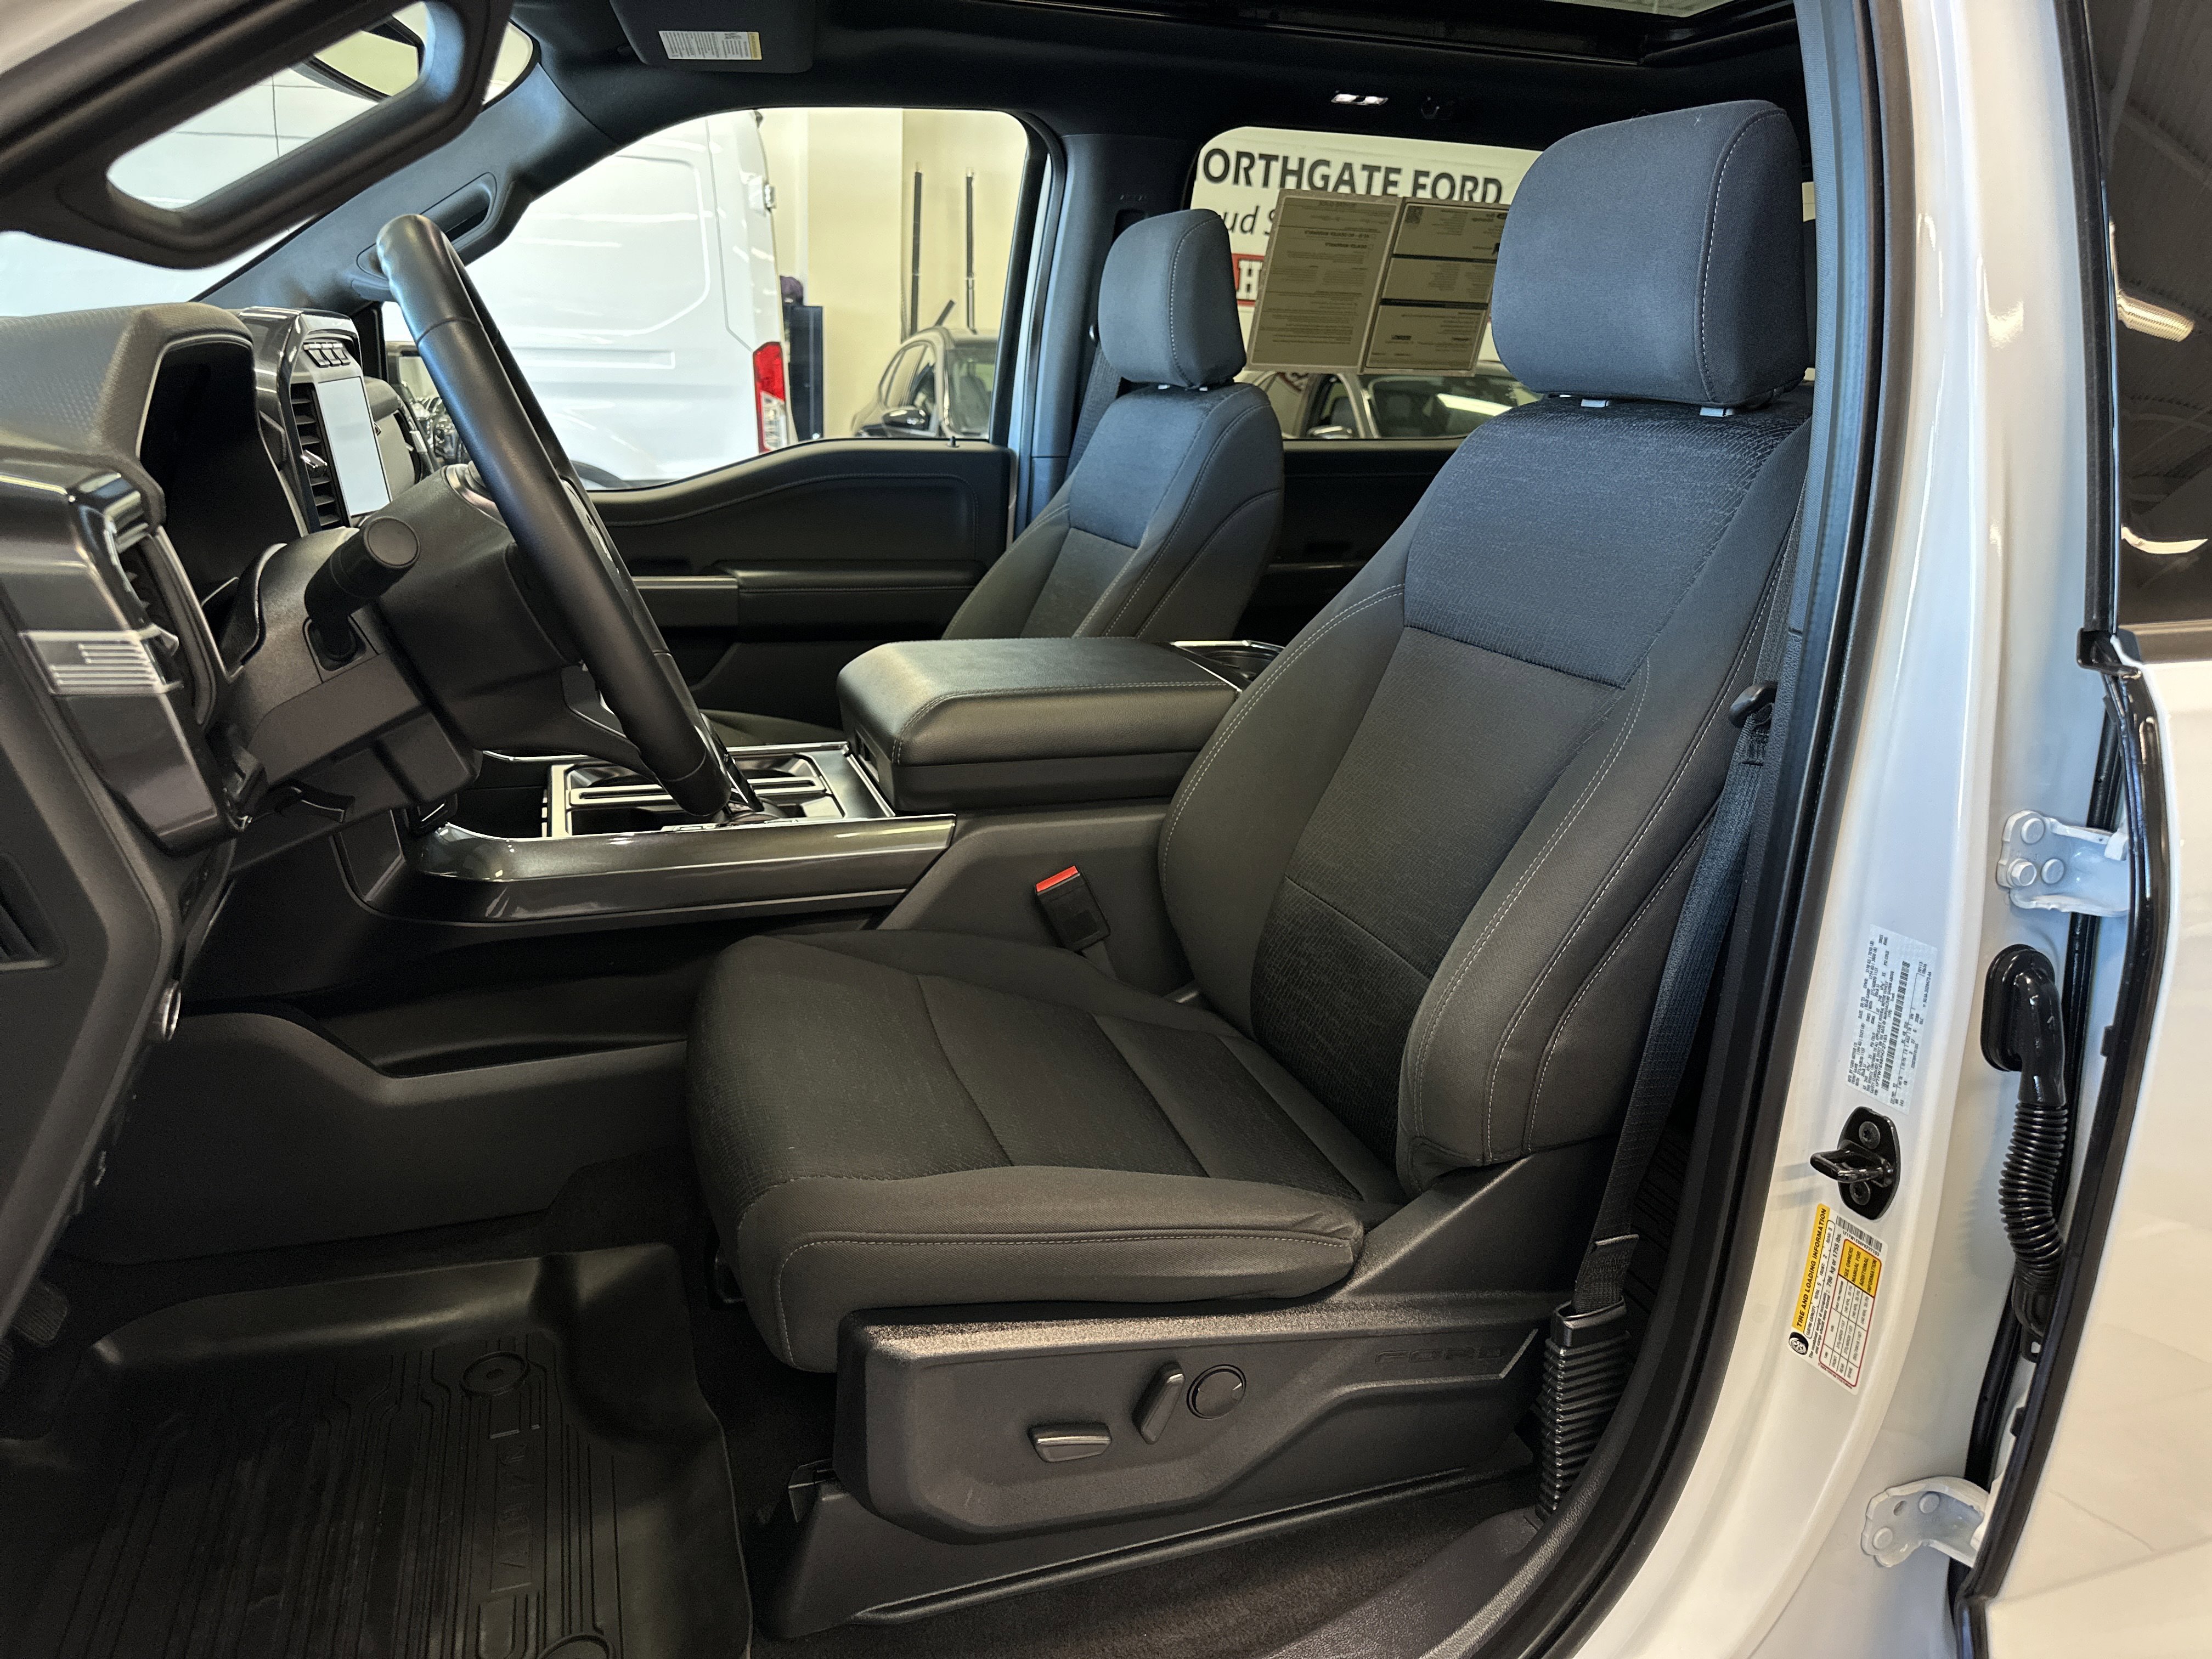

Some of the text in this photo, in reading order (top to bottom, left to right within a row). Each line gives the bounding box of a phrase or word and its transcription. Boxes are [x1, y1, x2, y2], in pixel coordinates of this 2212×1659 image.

[1203, 148, 1502, 204] ORTHGATE FORD
[1796, 1207, 1827, 1329] TIRE AND LOADING INFORMATION
[1829, 1265, 1836, 1275] kg
[1845, 1245, 1854, 1268] OWNERS
[1850, 1261, 1859, 1283] MANUAL
[1858, 1256, 1869, 1287] ADDITIONAL
[1866, 1258, 1877, 1293] INFORMATION
